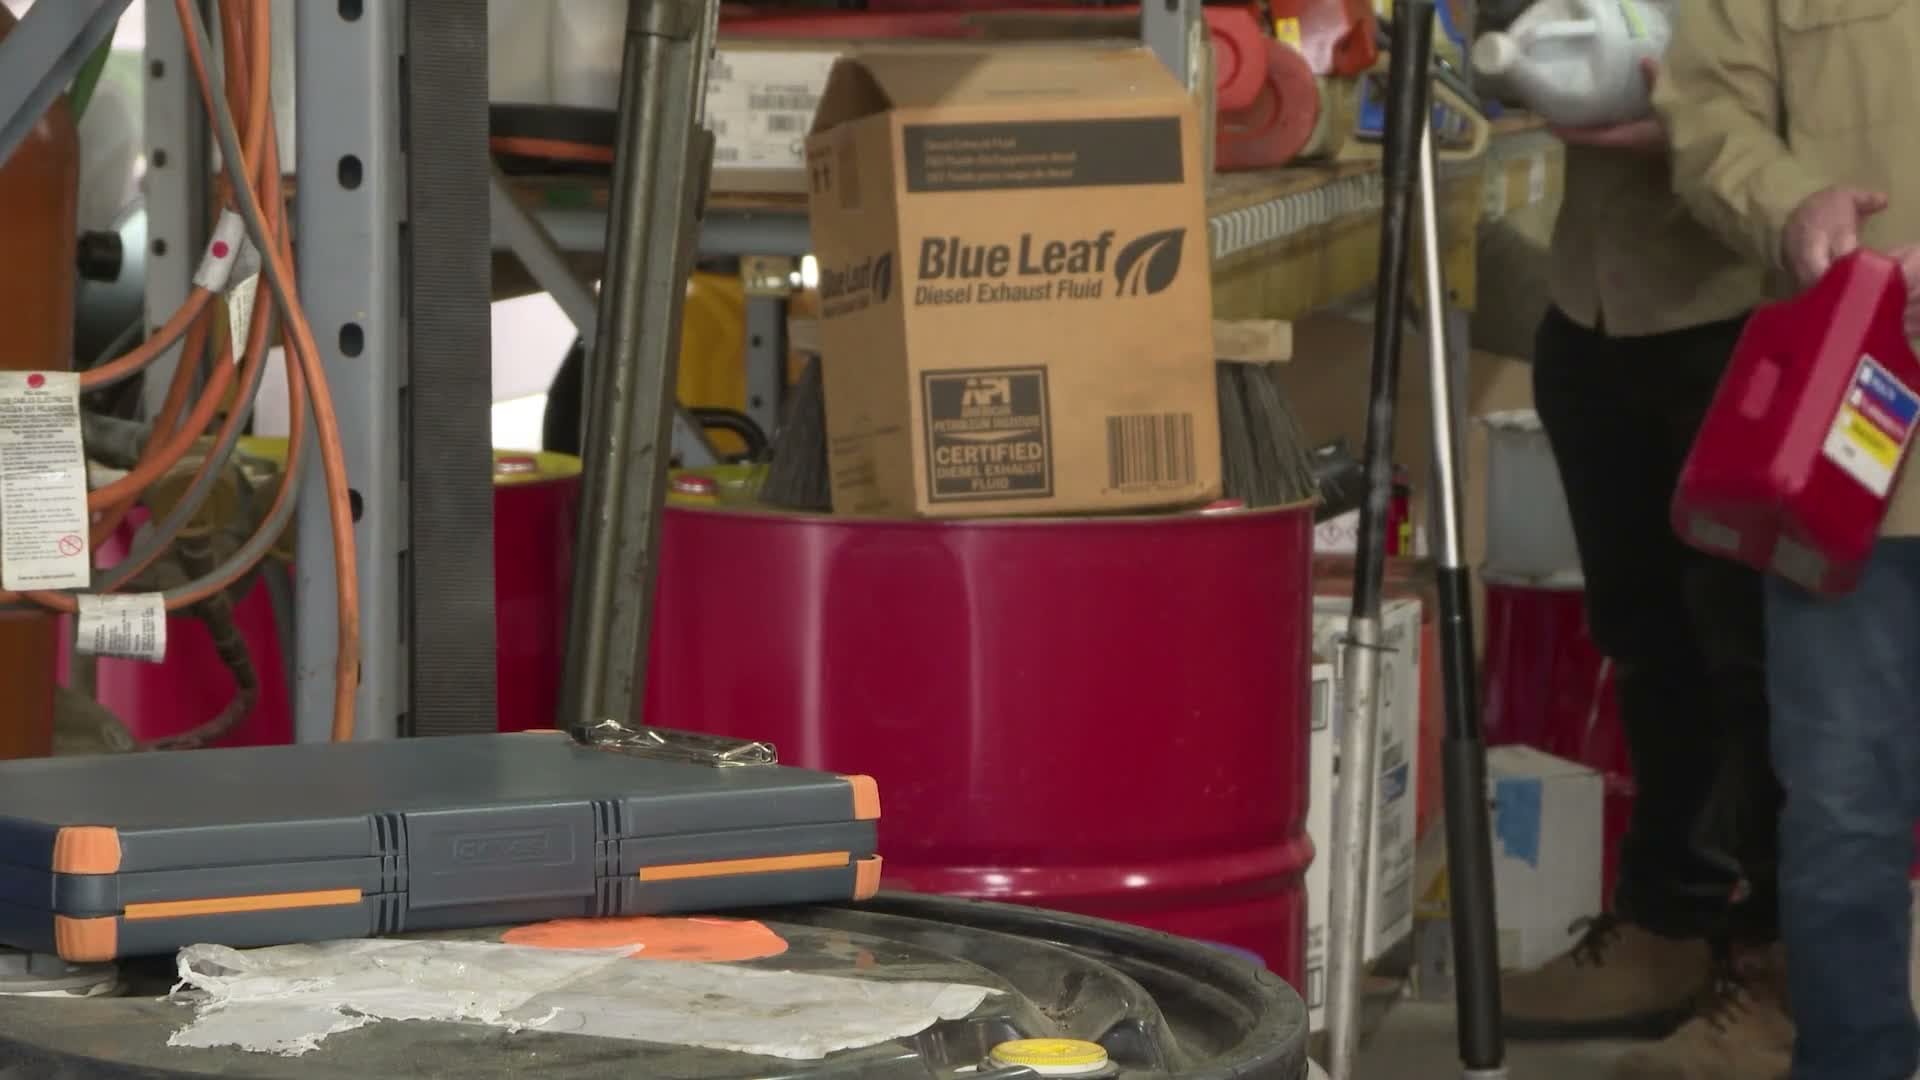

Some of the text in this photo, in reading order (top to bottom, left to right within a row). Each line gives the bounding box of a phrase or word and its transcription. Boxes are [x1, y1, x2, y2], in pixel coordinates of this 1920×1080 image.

[919, 228, 1115, 280] Blue Leaf
[915, 278, 1102, 306] Diesel Exhaust Fluid
[961, 376, 1011, 405] API
[936, 442, 1042, 465] CERTIFIED
[936, 462, 1042, 479] DIESEL EXHAUST
[971, 477, 1009, 491] FLUID
